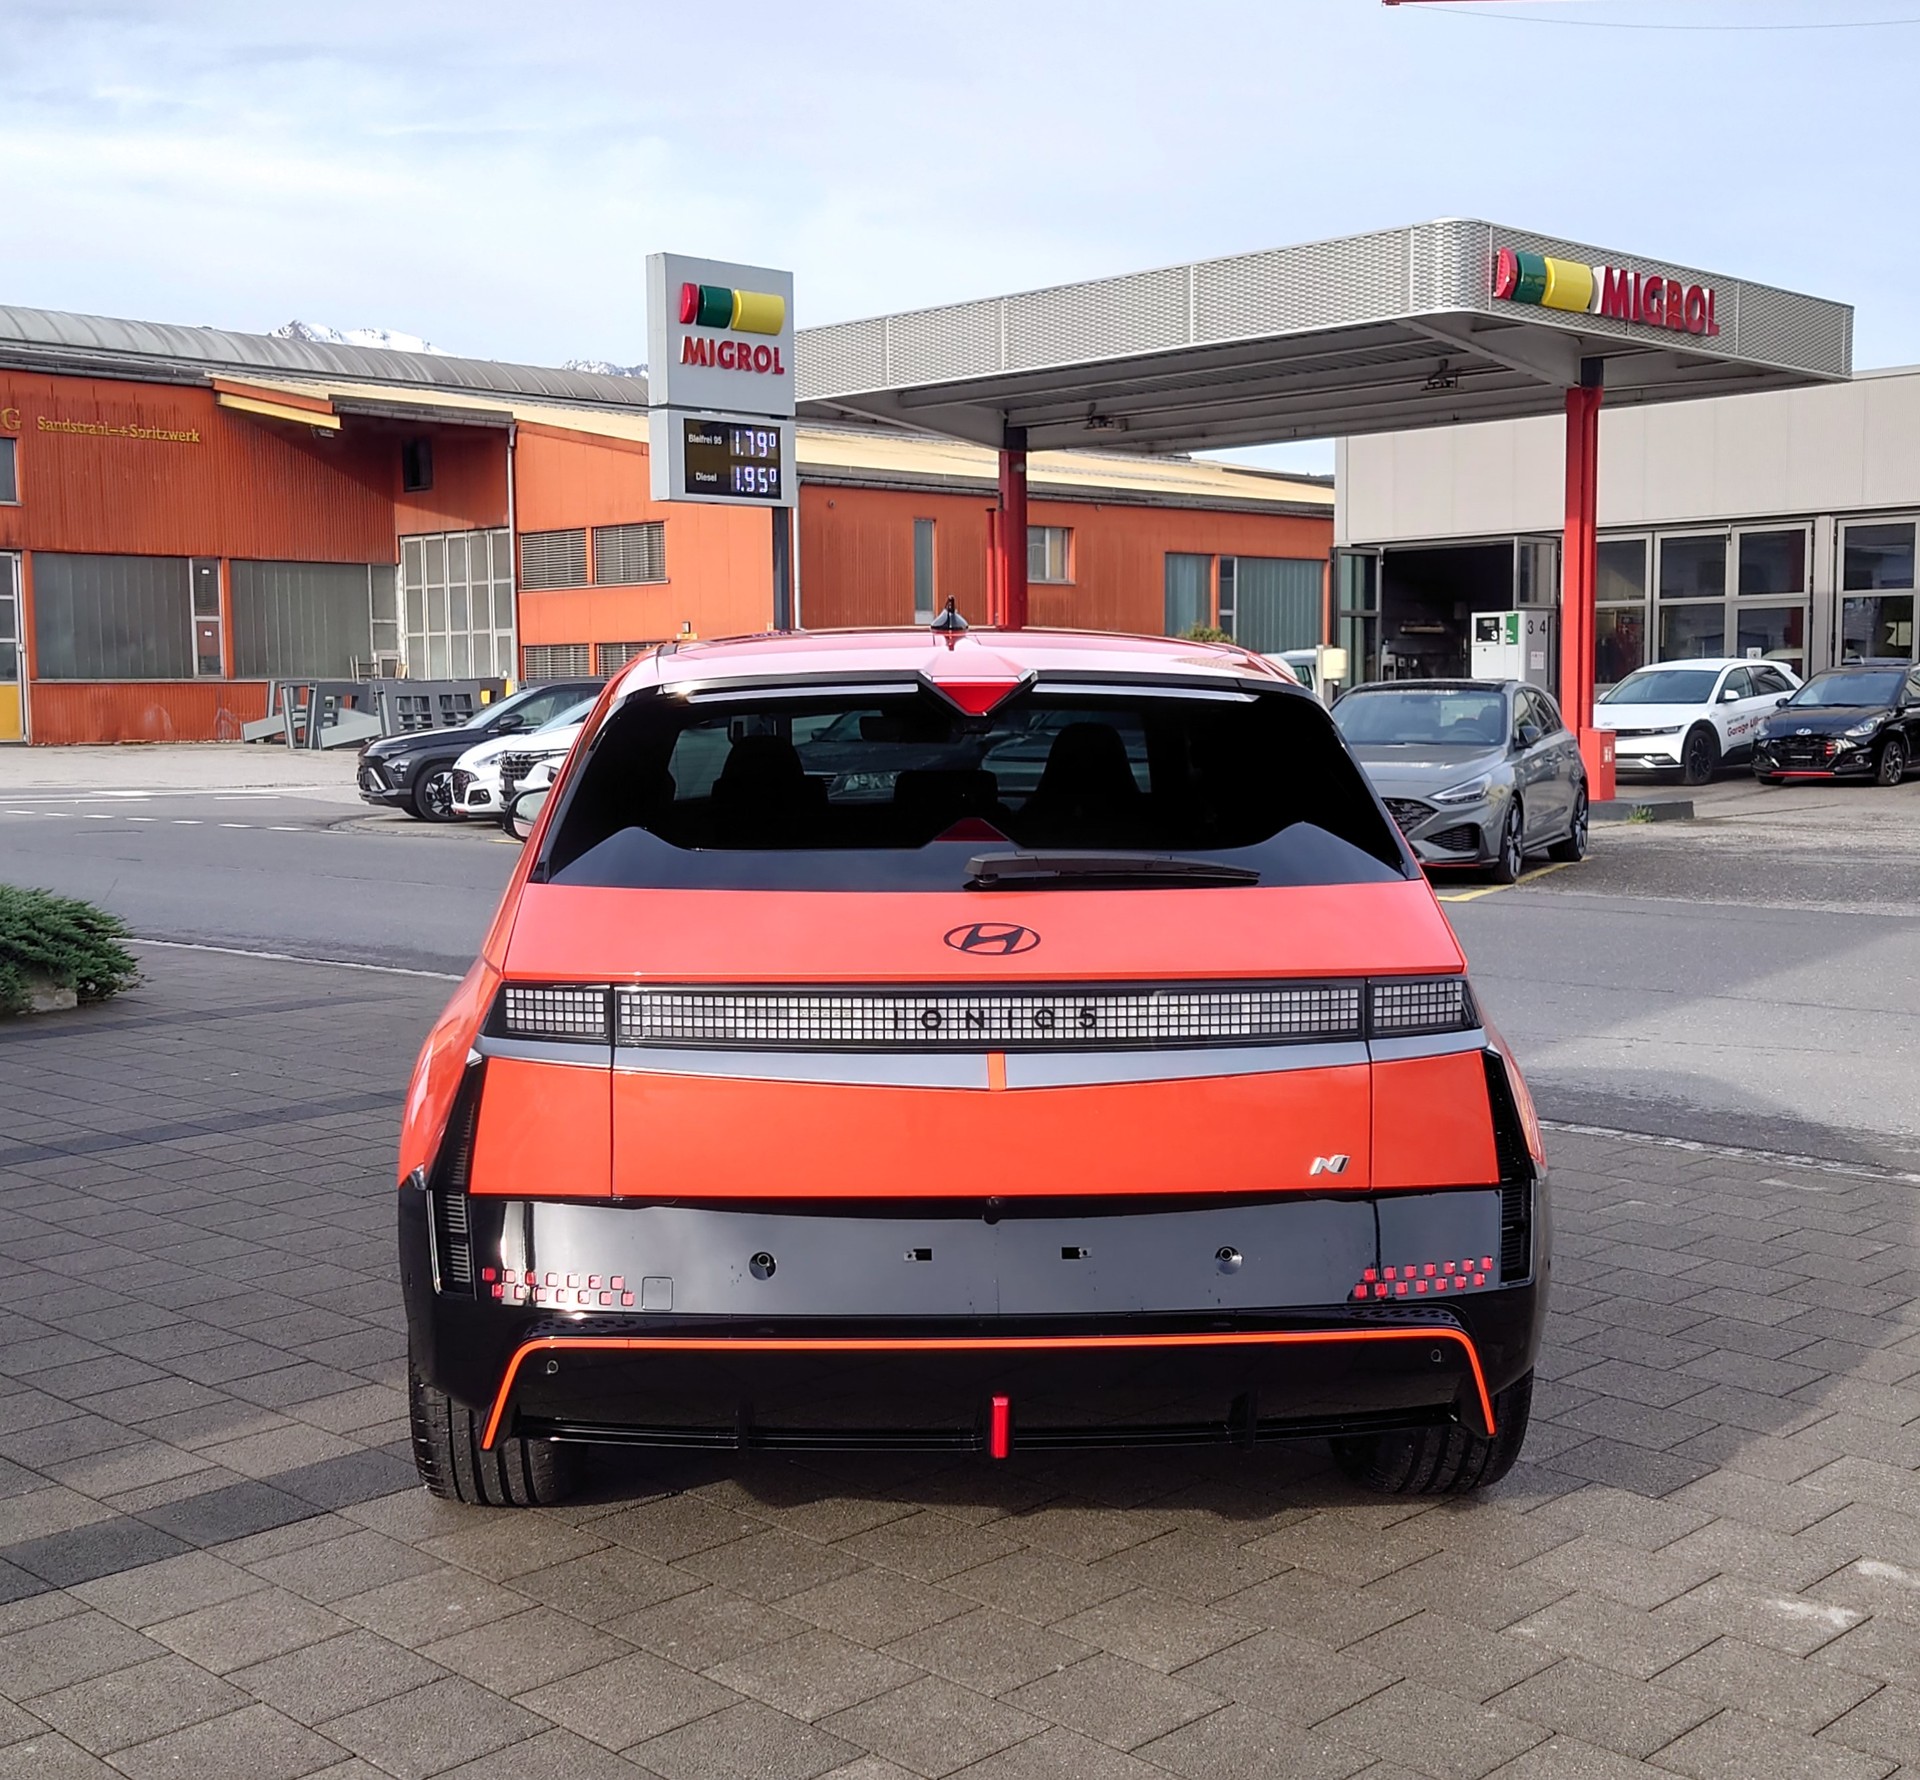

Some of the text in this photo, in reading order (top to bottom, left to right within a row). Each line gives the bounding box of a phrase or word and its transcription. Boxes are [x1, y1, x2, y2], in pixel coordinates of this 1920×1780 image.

[1595, 265, 1720, 336] MIGROL
[680, 335, 785, 375] MIGROL
[688, 433, 713, 445] Bleifrei
[695, 471, 717, 482] Diesel
[1527, 620, 1546, 635] 3 4
[1491, 630, 1498, 640] 3
[1727, 723, 1749, 737] Garage
